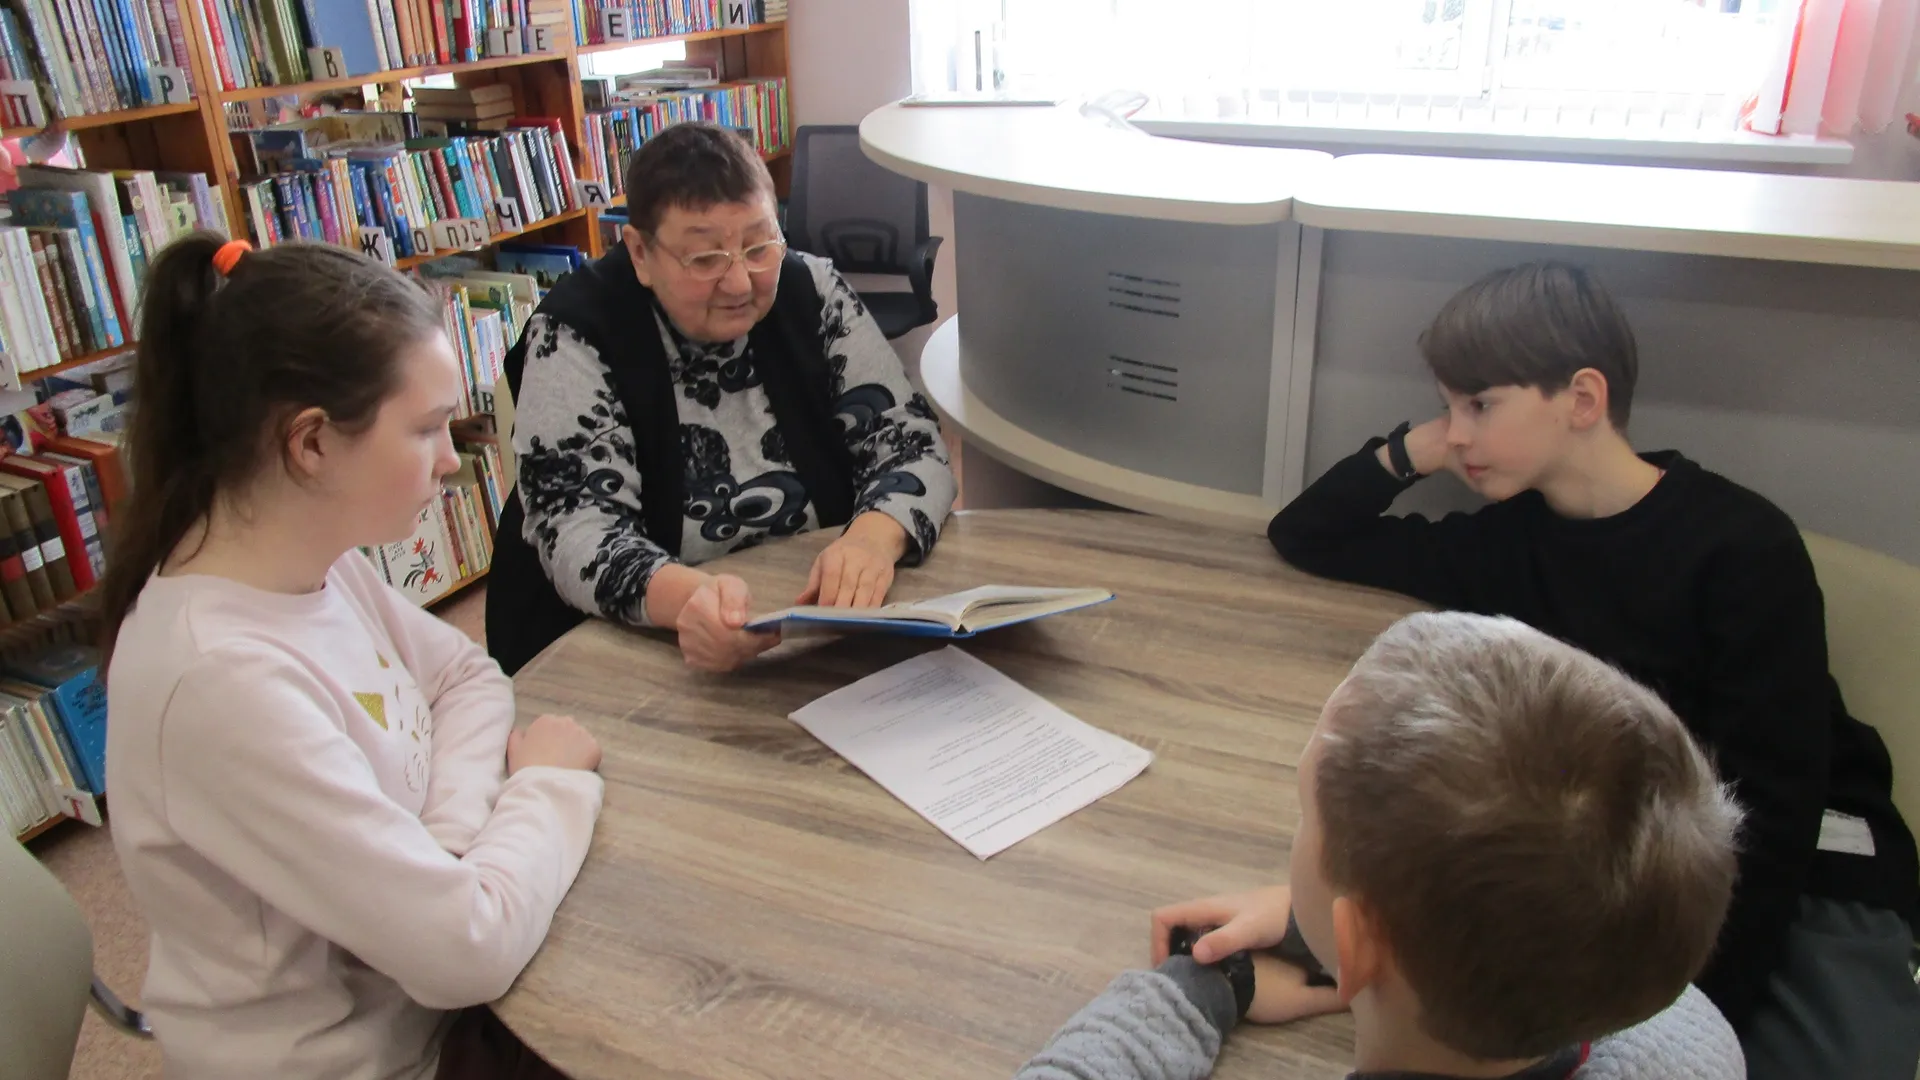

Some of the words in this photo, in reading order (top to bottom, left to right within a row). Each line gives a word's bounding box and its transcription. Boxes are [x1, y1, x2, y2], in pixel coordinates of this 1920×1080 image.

[608, 14, 624, 37] Е
[729, 4, 744, 24] И
[503, 30, 512, 54] Г
[536, 28, 548, 50] Е
[324, 51, 338, 78] В
[160, 75, 174, 104] Р
[584, 185, 605, 204] Я
[497, 202, 516, 227] Ч
[446, 226, 460, 247] П
[470, 221, 482, 242] С
[360, 233, 383, 261] Ж
